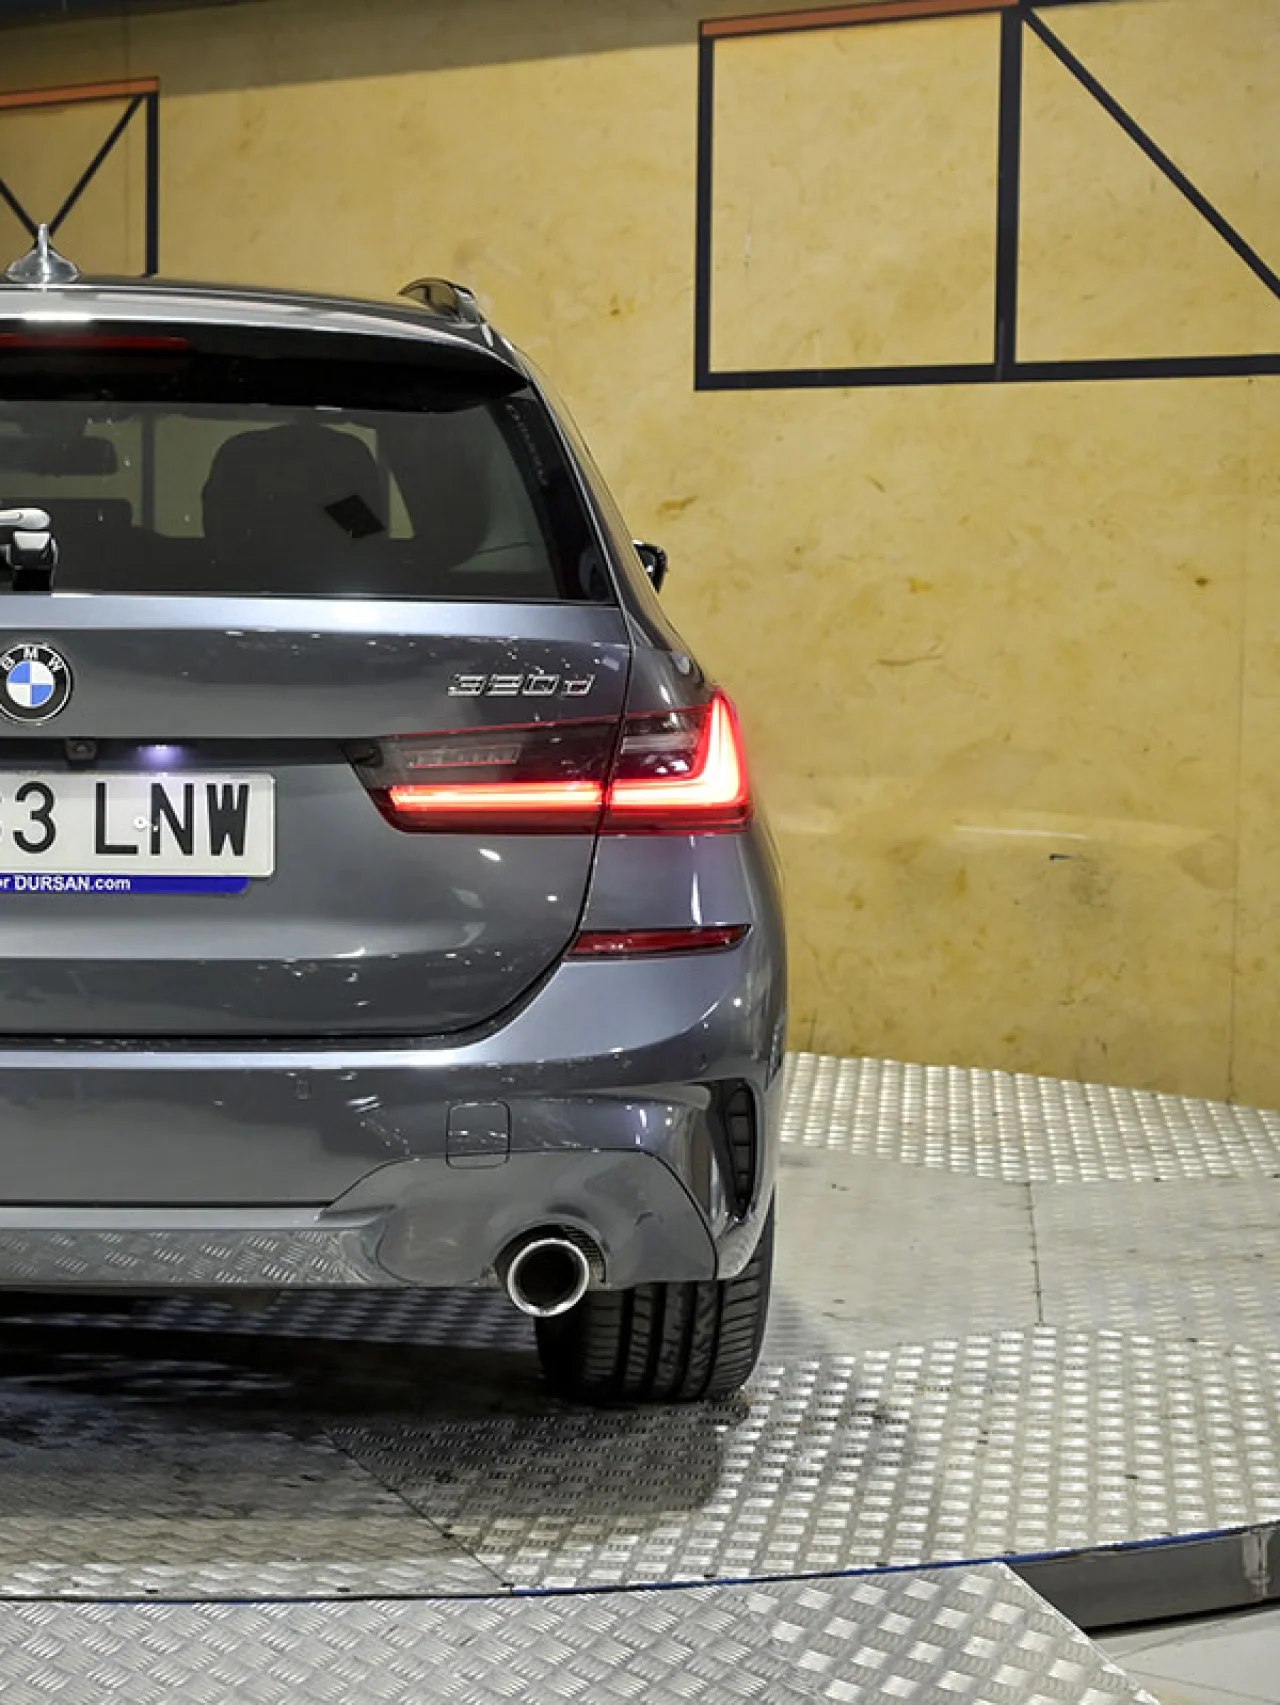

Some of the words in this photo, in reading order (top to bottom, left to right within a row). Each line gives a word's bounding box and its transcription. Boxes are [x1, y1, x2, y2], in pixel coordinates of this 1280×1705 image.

[448, 674, 596, 697] 320d
[95, 782, 251, 857] LNW
[14, 875, 132, 892] DURSAN.com
